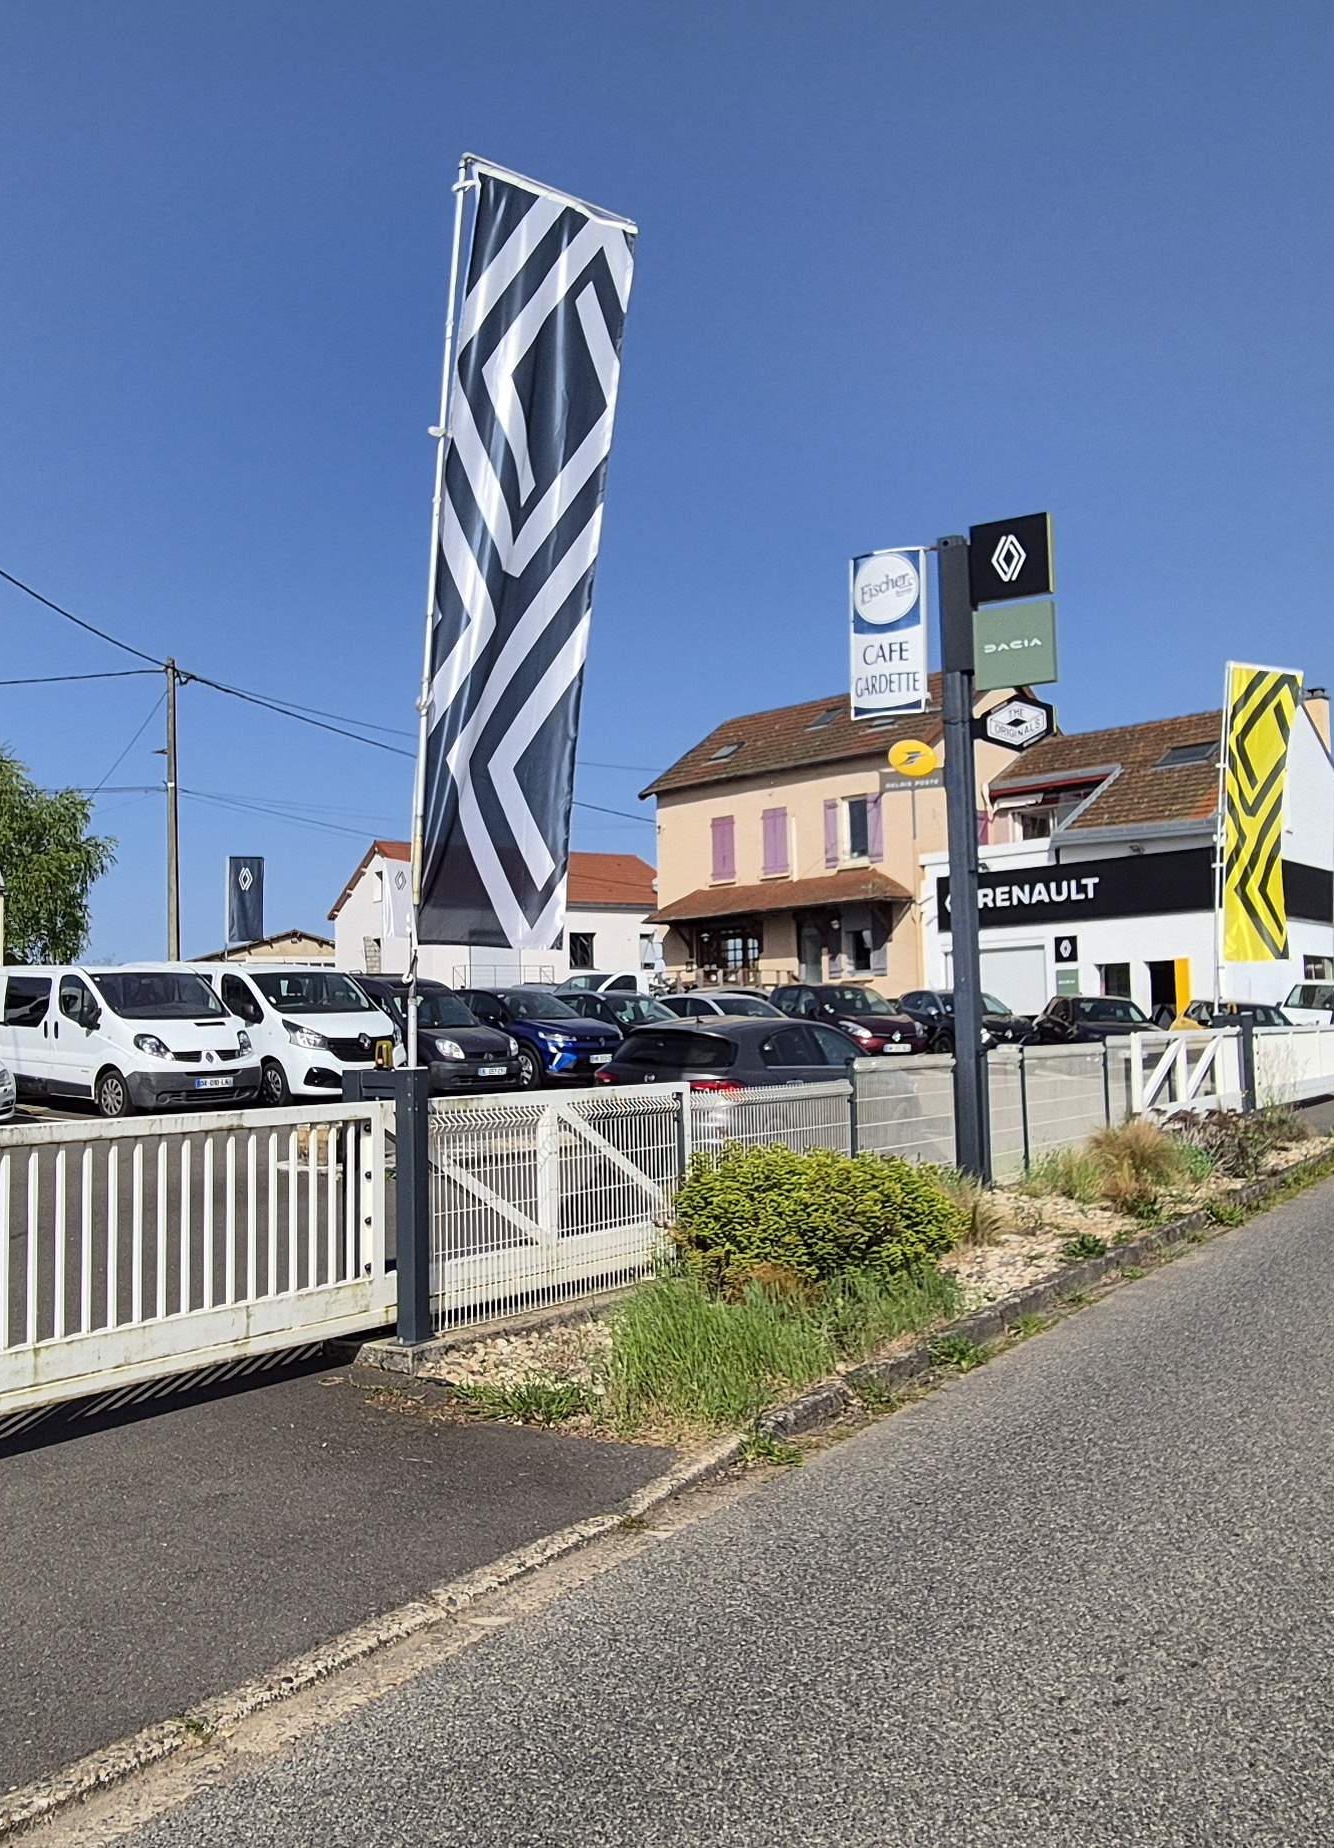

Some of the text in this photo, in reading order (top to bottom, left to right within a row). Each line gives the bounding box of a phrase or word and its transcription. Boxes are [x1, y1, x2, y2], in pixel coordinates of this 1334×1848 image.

[860, 573, 910, 605] Fischer
[863, 641, 909, 665] CAFE
[984, 638, 1042, 653] DACIA
[855, 671, 920, 698] GARDETTE
[1008, 708, 1025, 719] THE
[994, 718, 1041, 738] ORIGINALS
[977, 877, 1100, 909] RENAULT
